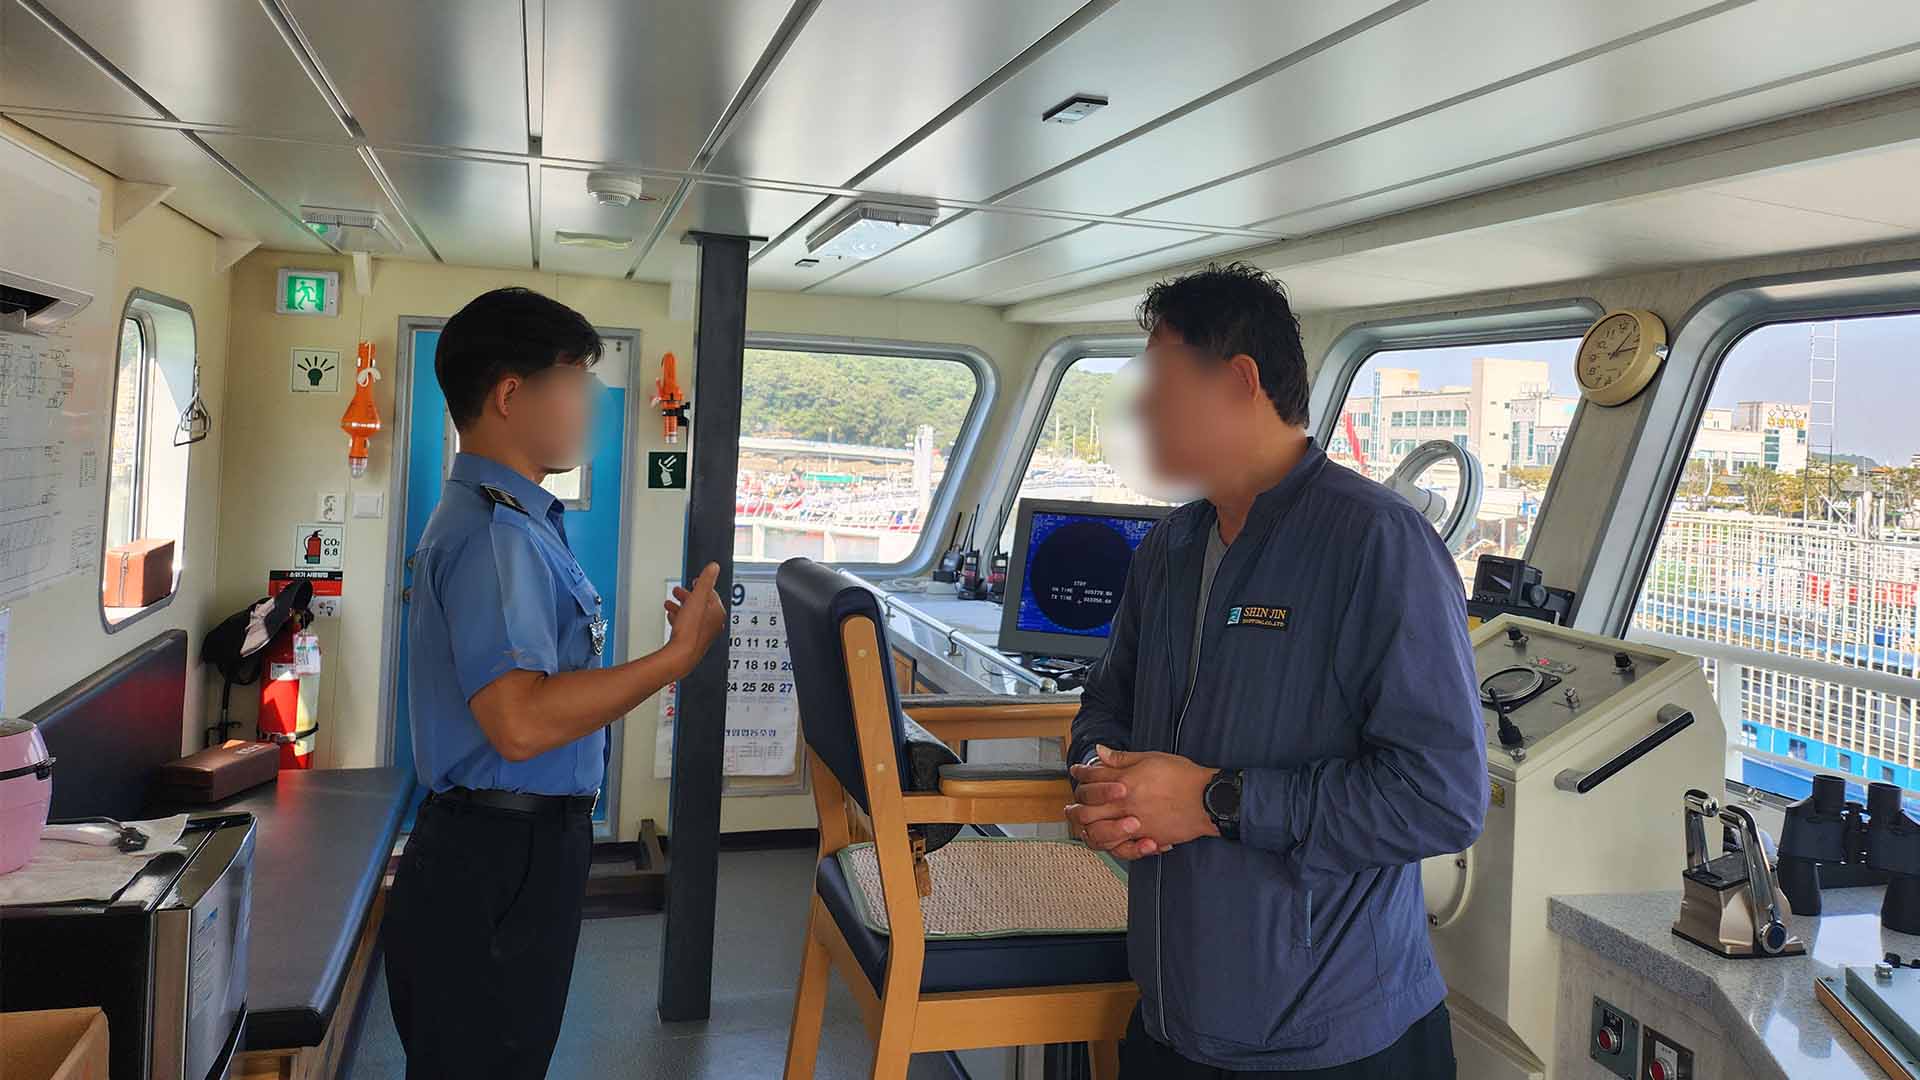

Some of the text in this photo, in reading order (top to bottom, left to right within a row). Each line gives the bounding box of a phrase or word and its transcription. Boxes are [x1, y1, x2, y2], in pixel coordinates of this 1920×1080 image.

[731, 583, 746, 606] 9
[1243, 607, 1286, 618] SHIN JIN
[732, 615, 777, 626] 3 4 5
[729, 637, 741, 647] 10
[747, 637, 759, 647] 11
[765, 638, 778, 648] 12
[744, 660, 758, 670] 18
[763, 660, 777, 670] 19
[781, 661, 793, 671] 20
[742, 682, 757, 692] 25
[760, 682, 775, 692] 26
[779, 683, 793, 693] 27
